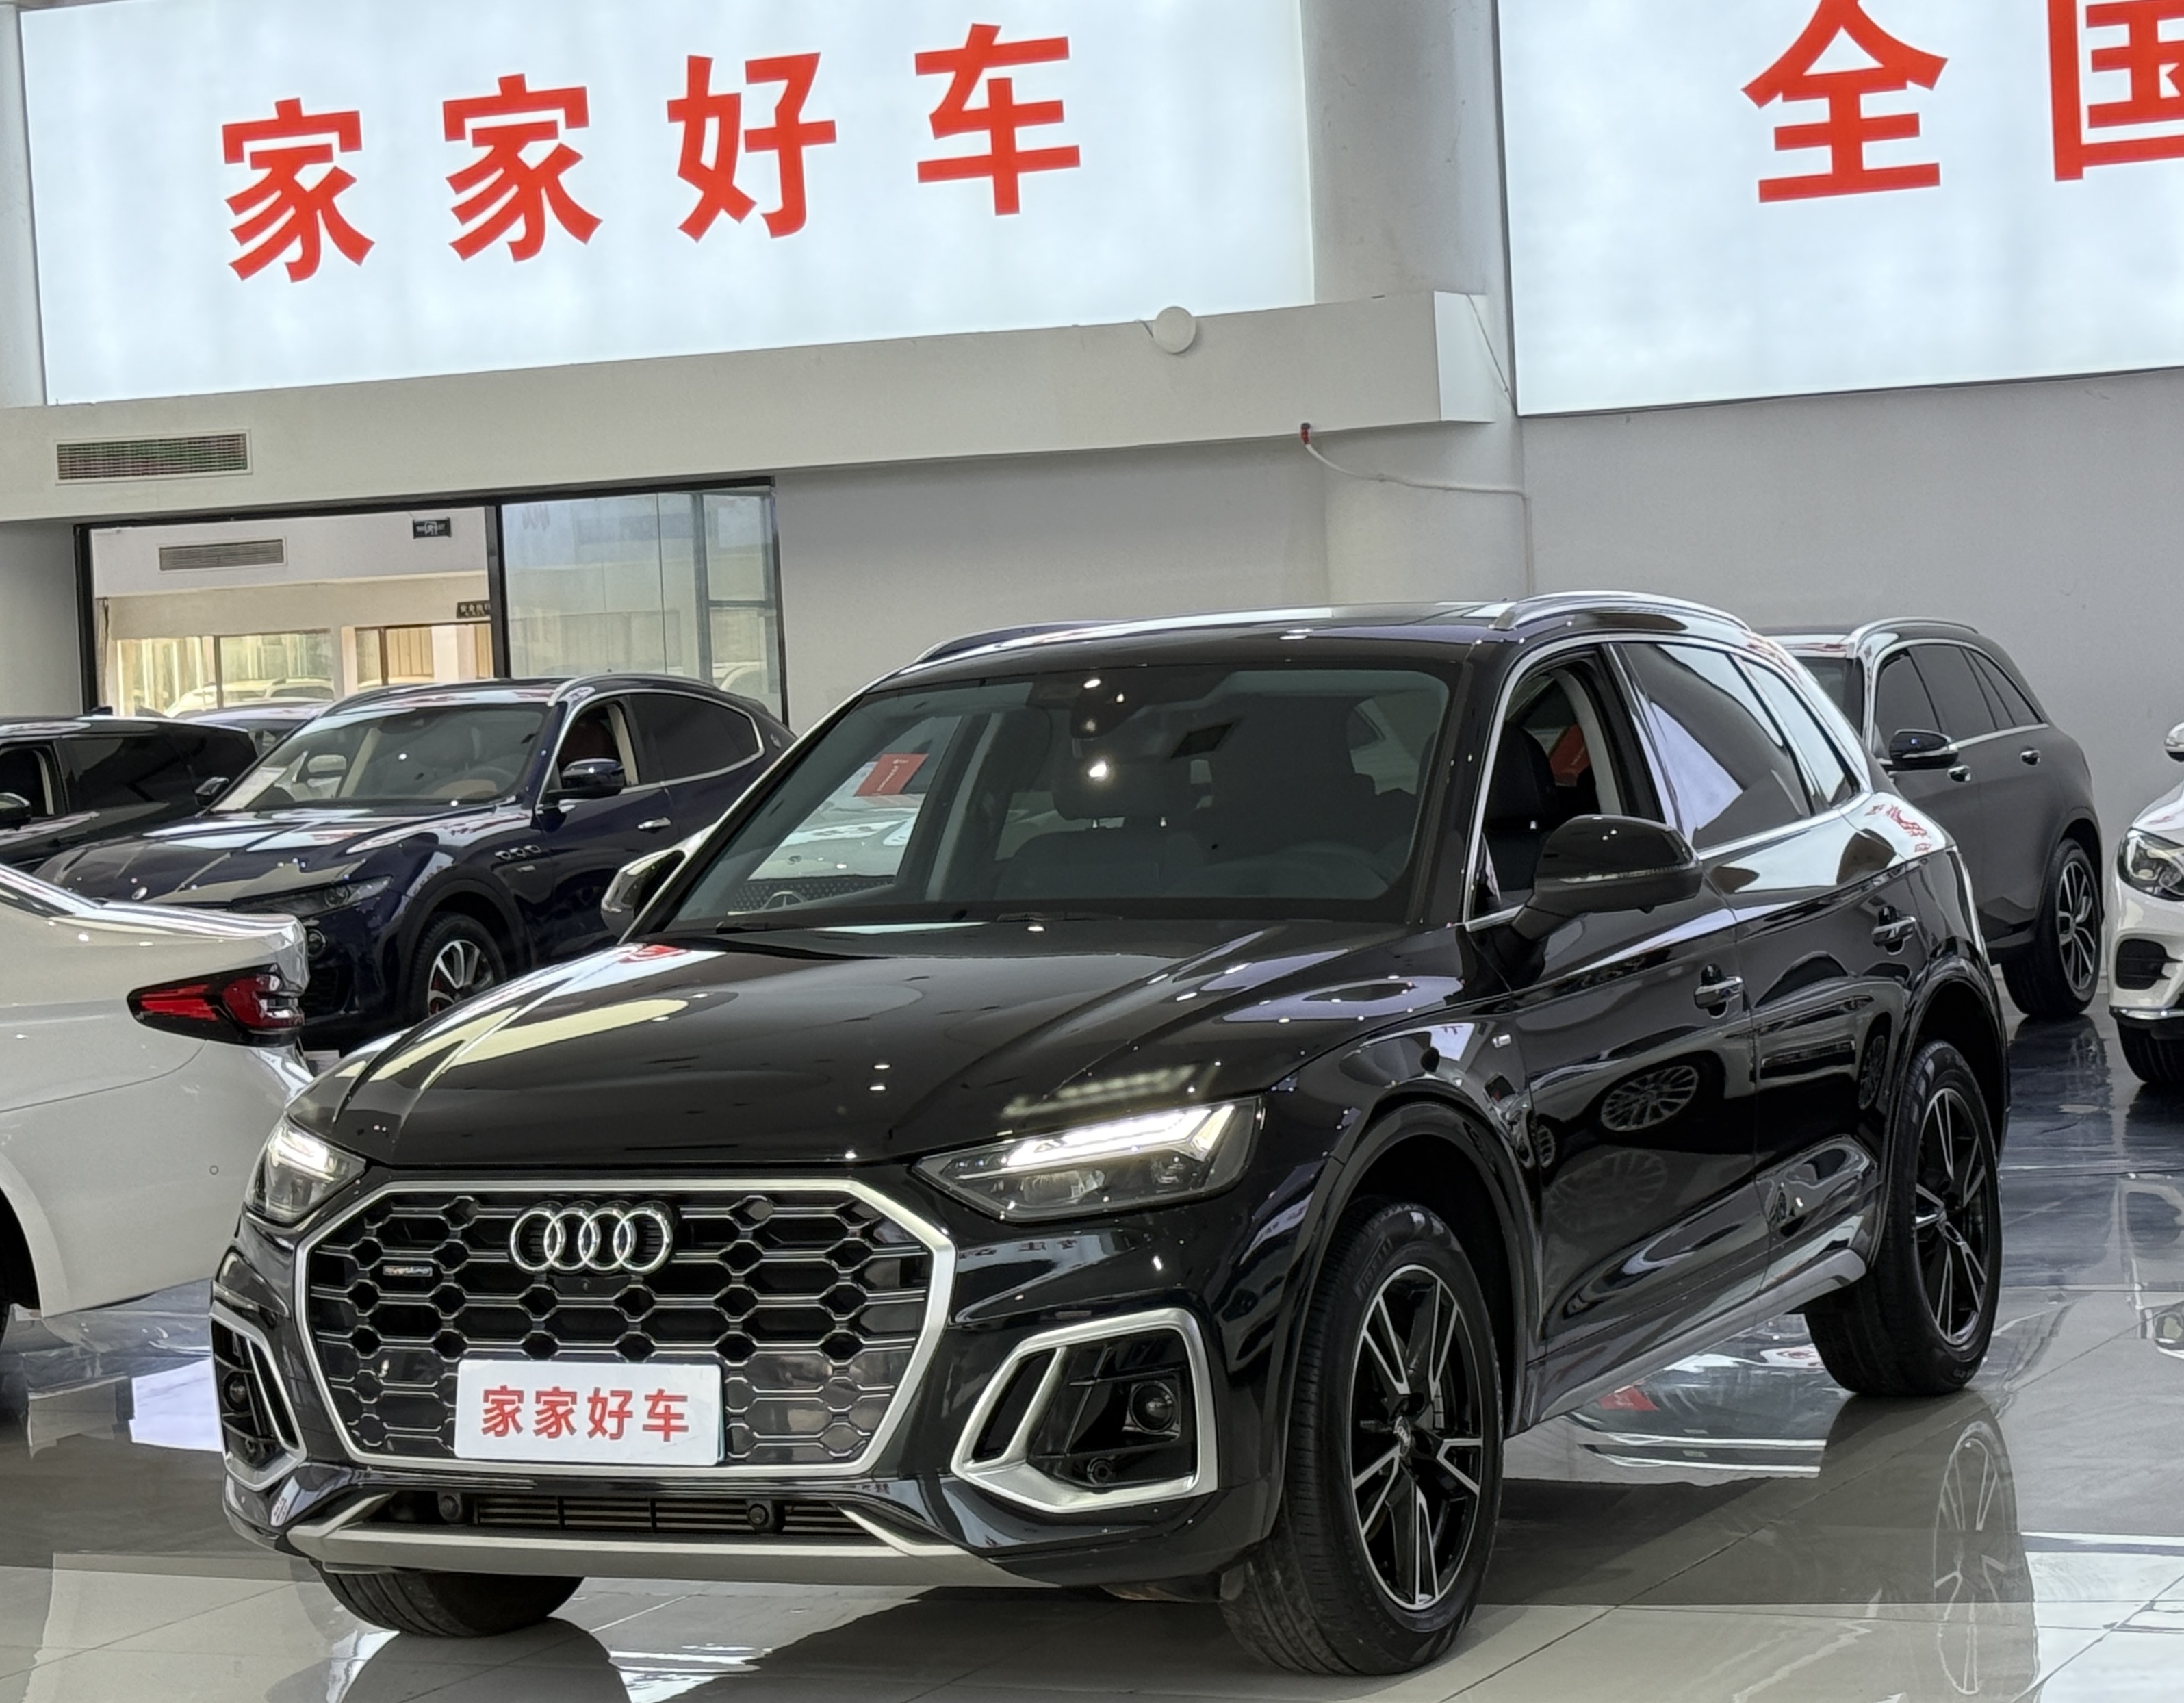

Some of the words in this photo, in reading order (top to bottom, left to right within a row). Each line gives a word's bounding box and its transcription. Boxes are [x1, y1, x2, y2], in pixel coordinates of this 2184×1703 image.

[222, 25, 1080, 283] 家家好车
[1745, 0, 2184, 203] 全国
[481, 1385, 689, 1442] 家家好车
